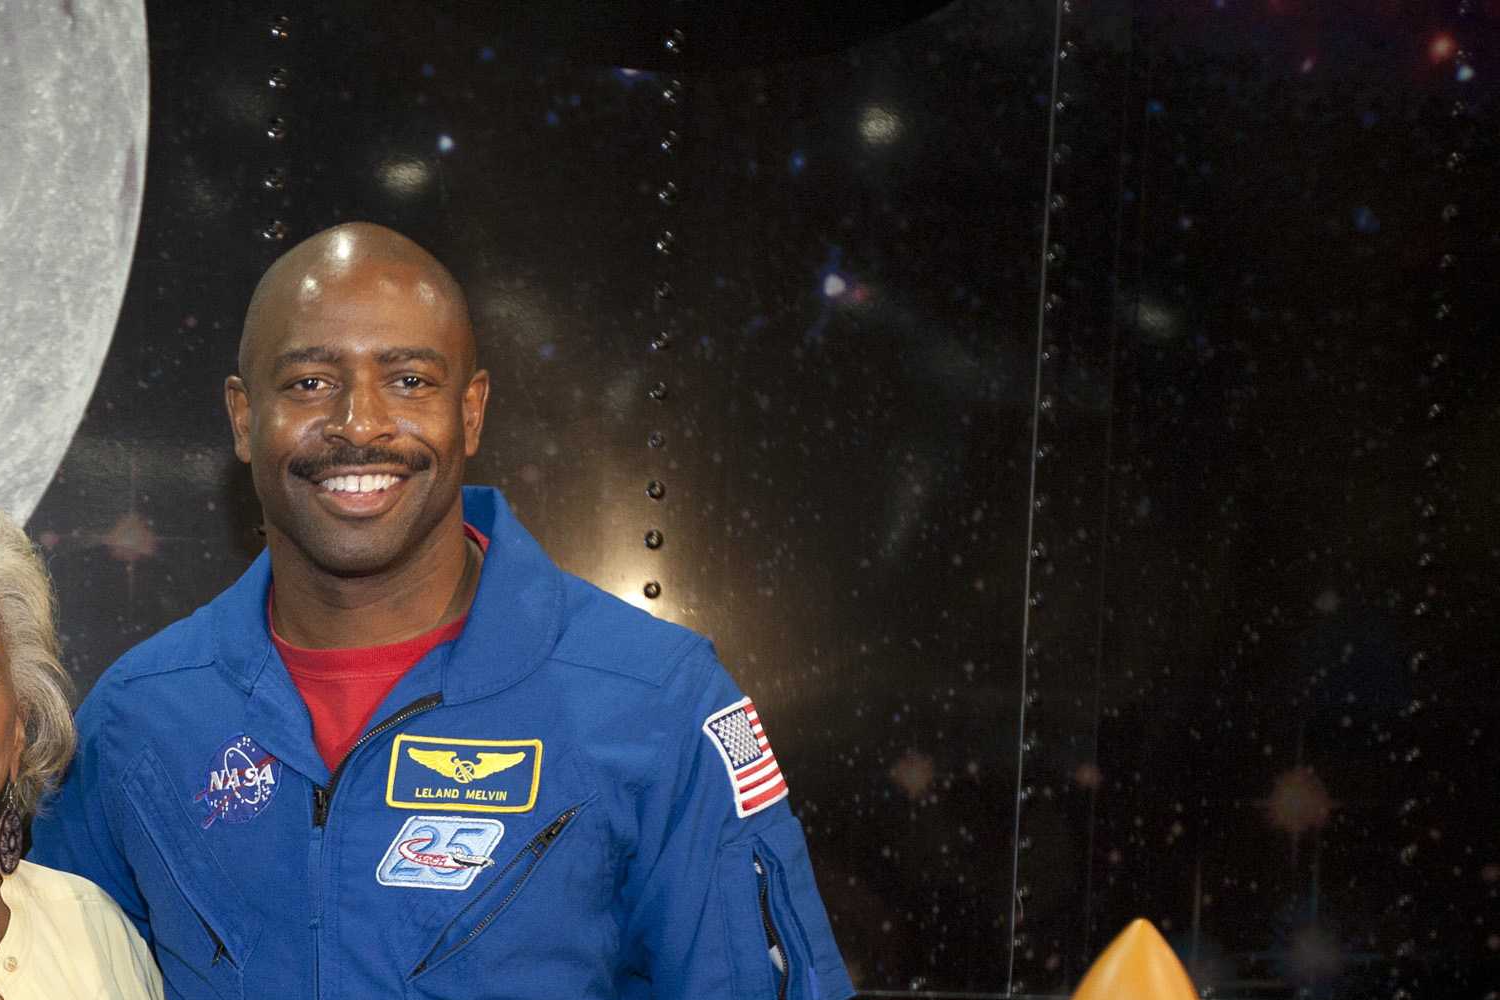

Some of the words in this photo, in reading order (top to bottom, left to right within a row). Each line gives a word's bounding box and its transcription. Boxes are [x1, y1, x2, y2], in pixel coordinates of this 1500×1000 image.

[209, 763, 275, 792] NASA
[415, 787, 460, 799] LELAND
[465, 789, 508, 801] MELVIN
